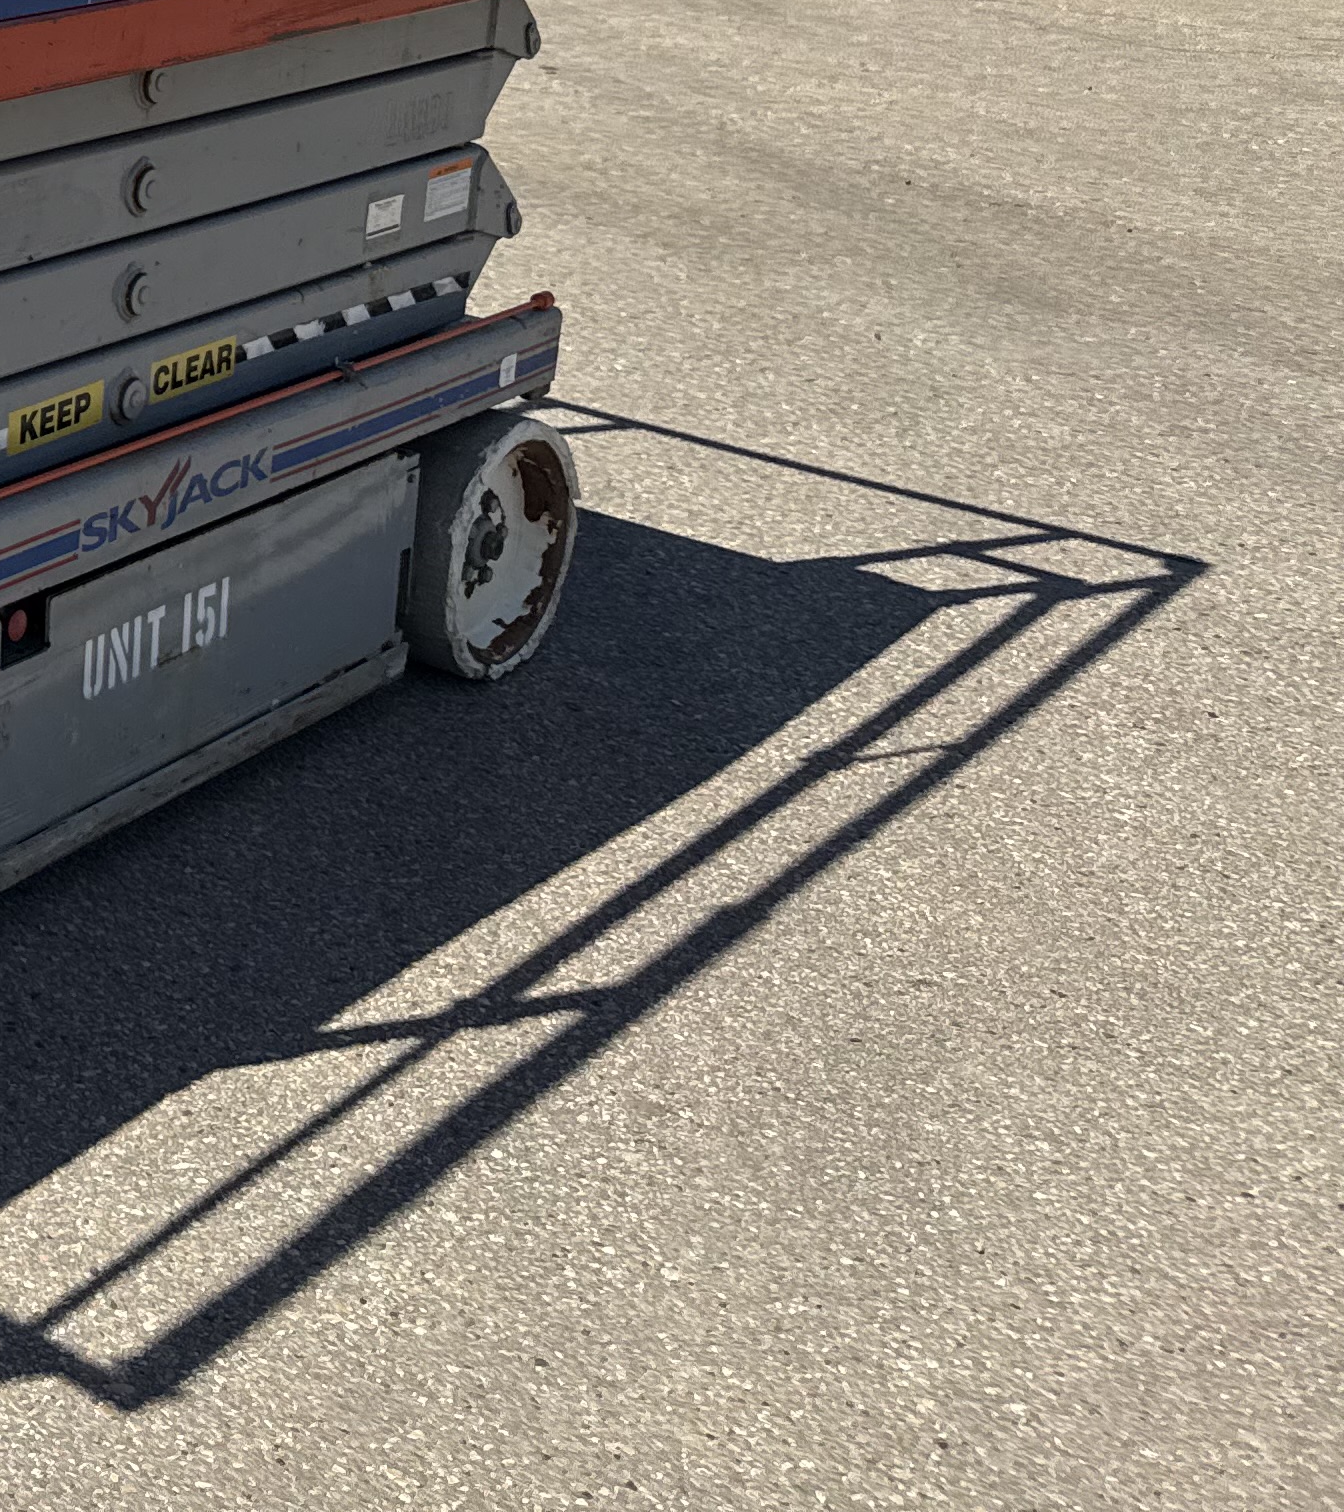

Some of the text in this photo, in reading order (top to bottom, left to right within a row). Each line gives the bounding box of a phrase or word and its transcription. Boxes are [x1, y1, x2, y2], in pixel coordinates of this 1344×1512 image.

[20, 343, 233, 444] KEEP CLEAR
[81, 446, 269, 553] SKYJACK
[83, 605, 166, 700] UNIT
[182, 576, 230, 653] 151
